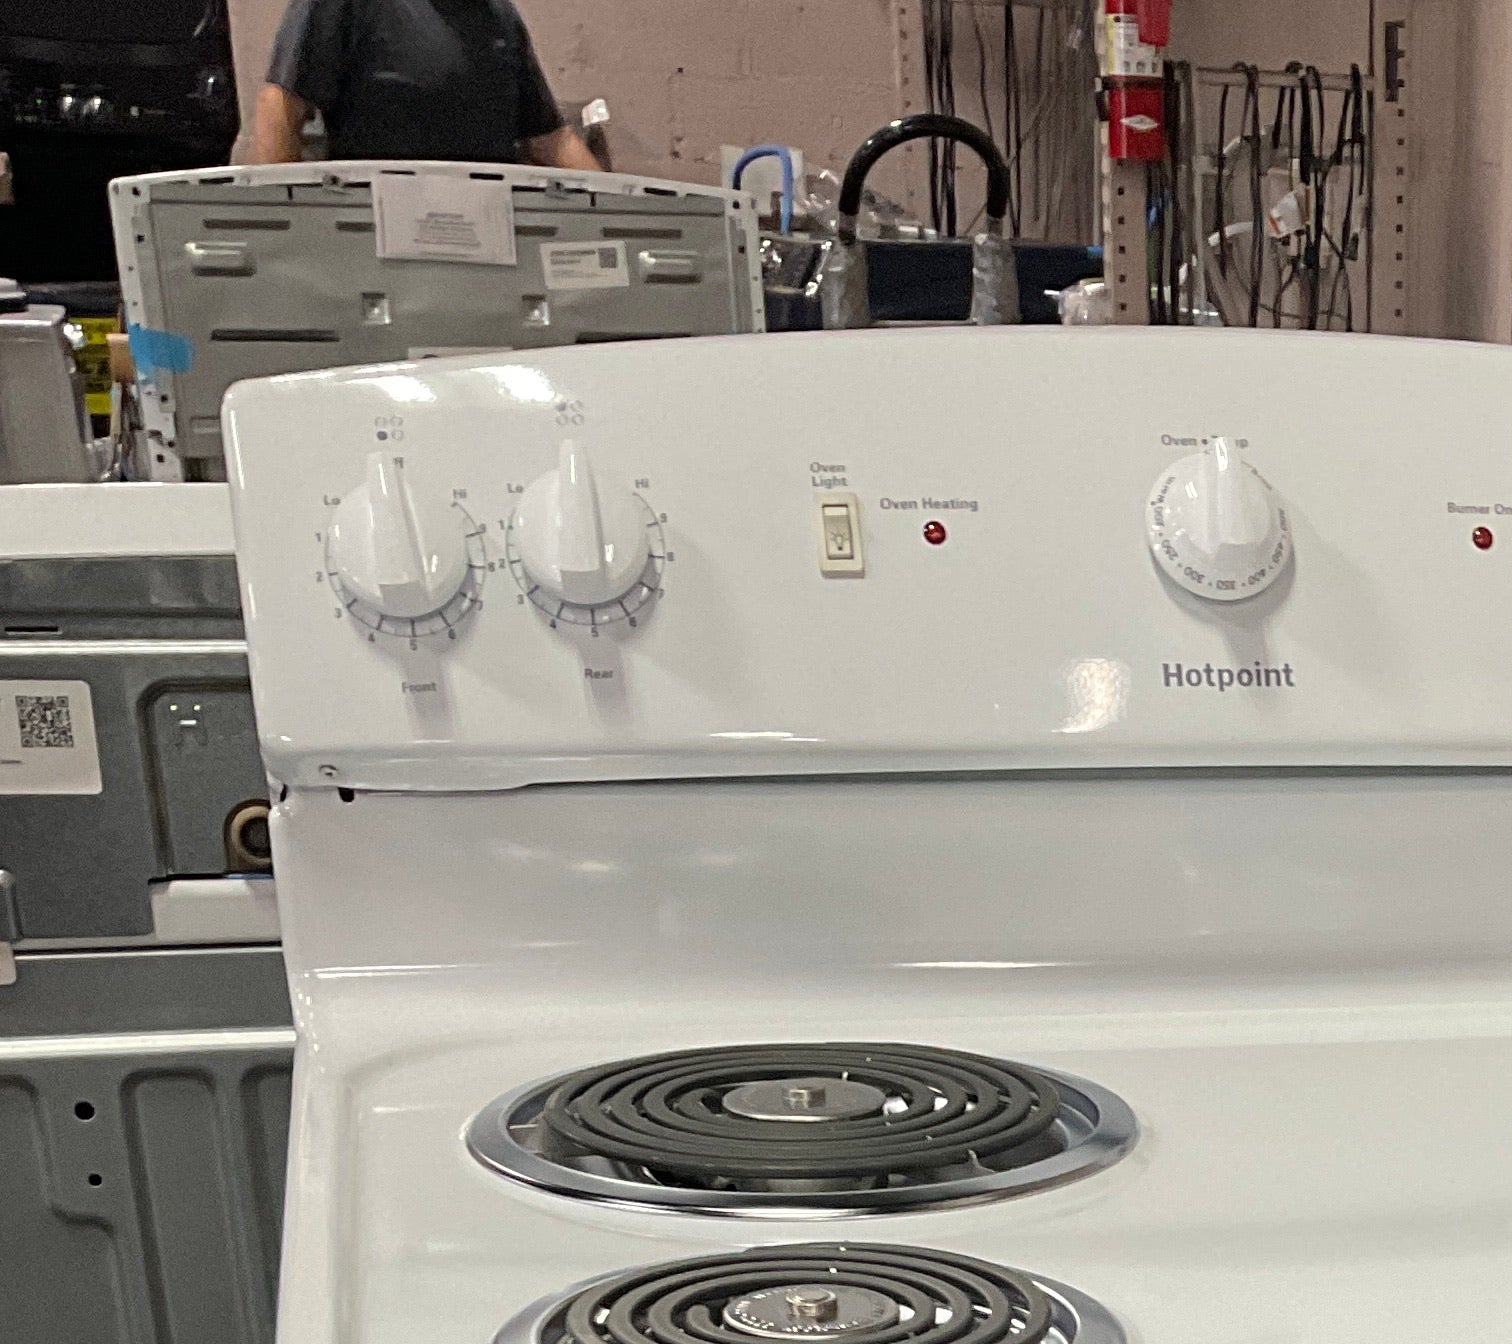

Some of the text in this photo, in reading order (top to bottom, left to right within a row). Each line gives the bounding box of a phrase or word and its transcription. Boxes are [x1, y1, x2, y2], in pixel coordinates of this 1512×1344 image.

[810, 462, 846, 473] Oven
[812, 476, 848, 489] Light
[880, 497, 979, 512] Oven Heating
[585, 668, 614, 679] Rear
[1162, 661, 1295, 692] Hotpoint
[402, 682, 437, 693] Front
